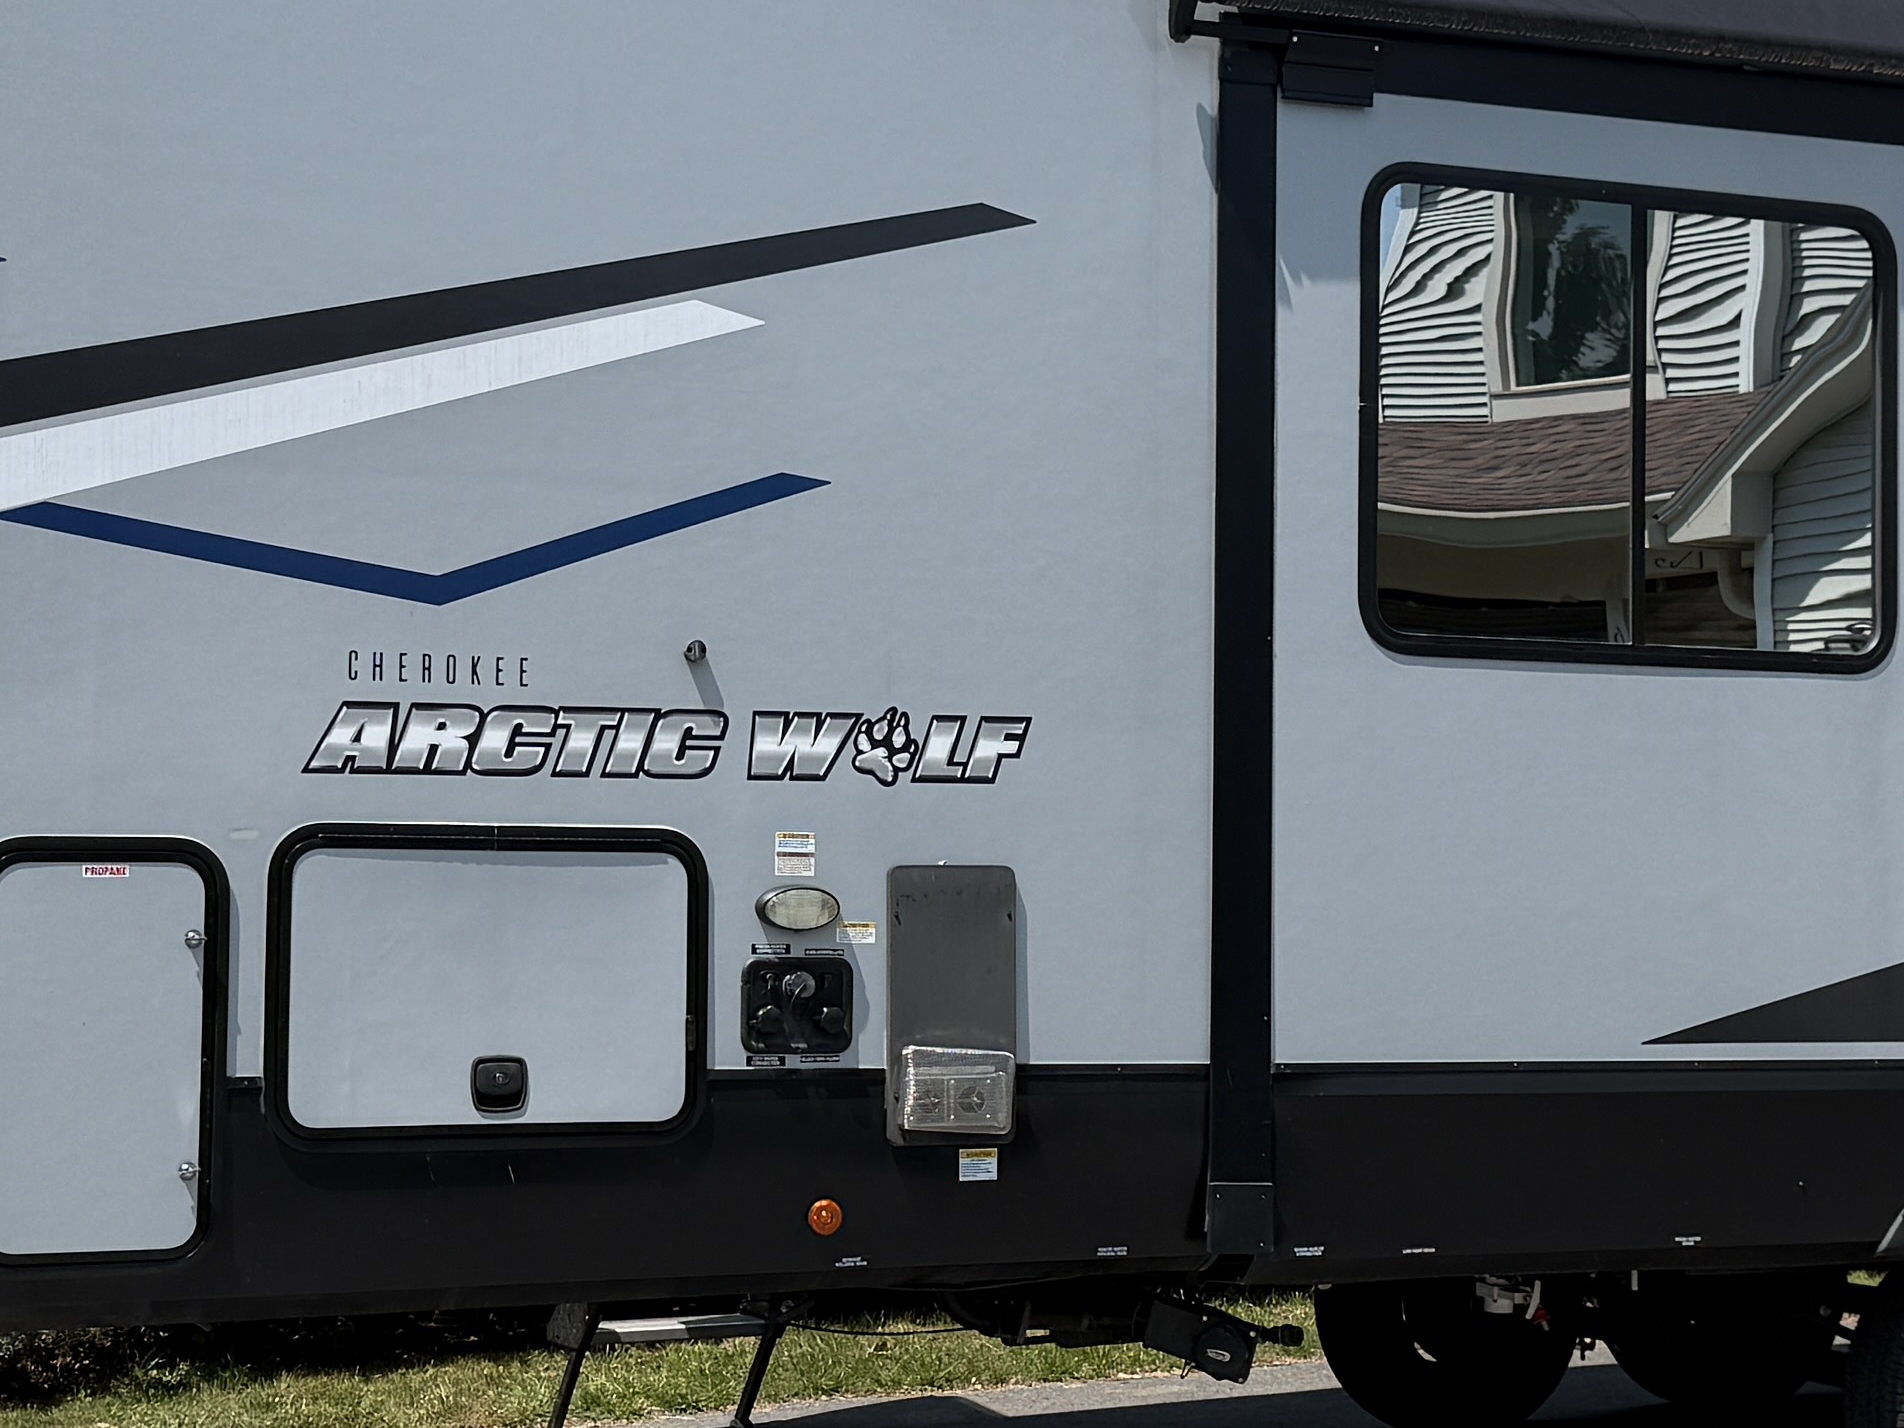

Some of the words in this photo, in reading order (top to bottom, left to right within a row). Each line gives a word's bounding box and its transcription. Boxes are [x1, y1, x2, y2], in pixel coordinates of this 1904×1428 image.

[348, 649, 529, 688] CHEROKEE
[300, 700, 729, 780] ARCTIC
[84, 866, 127, 876] PROPANE
